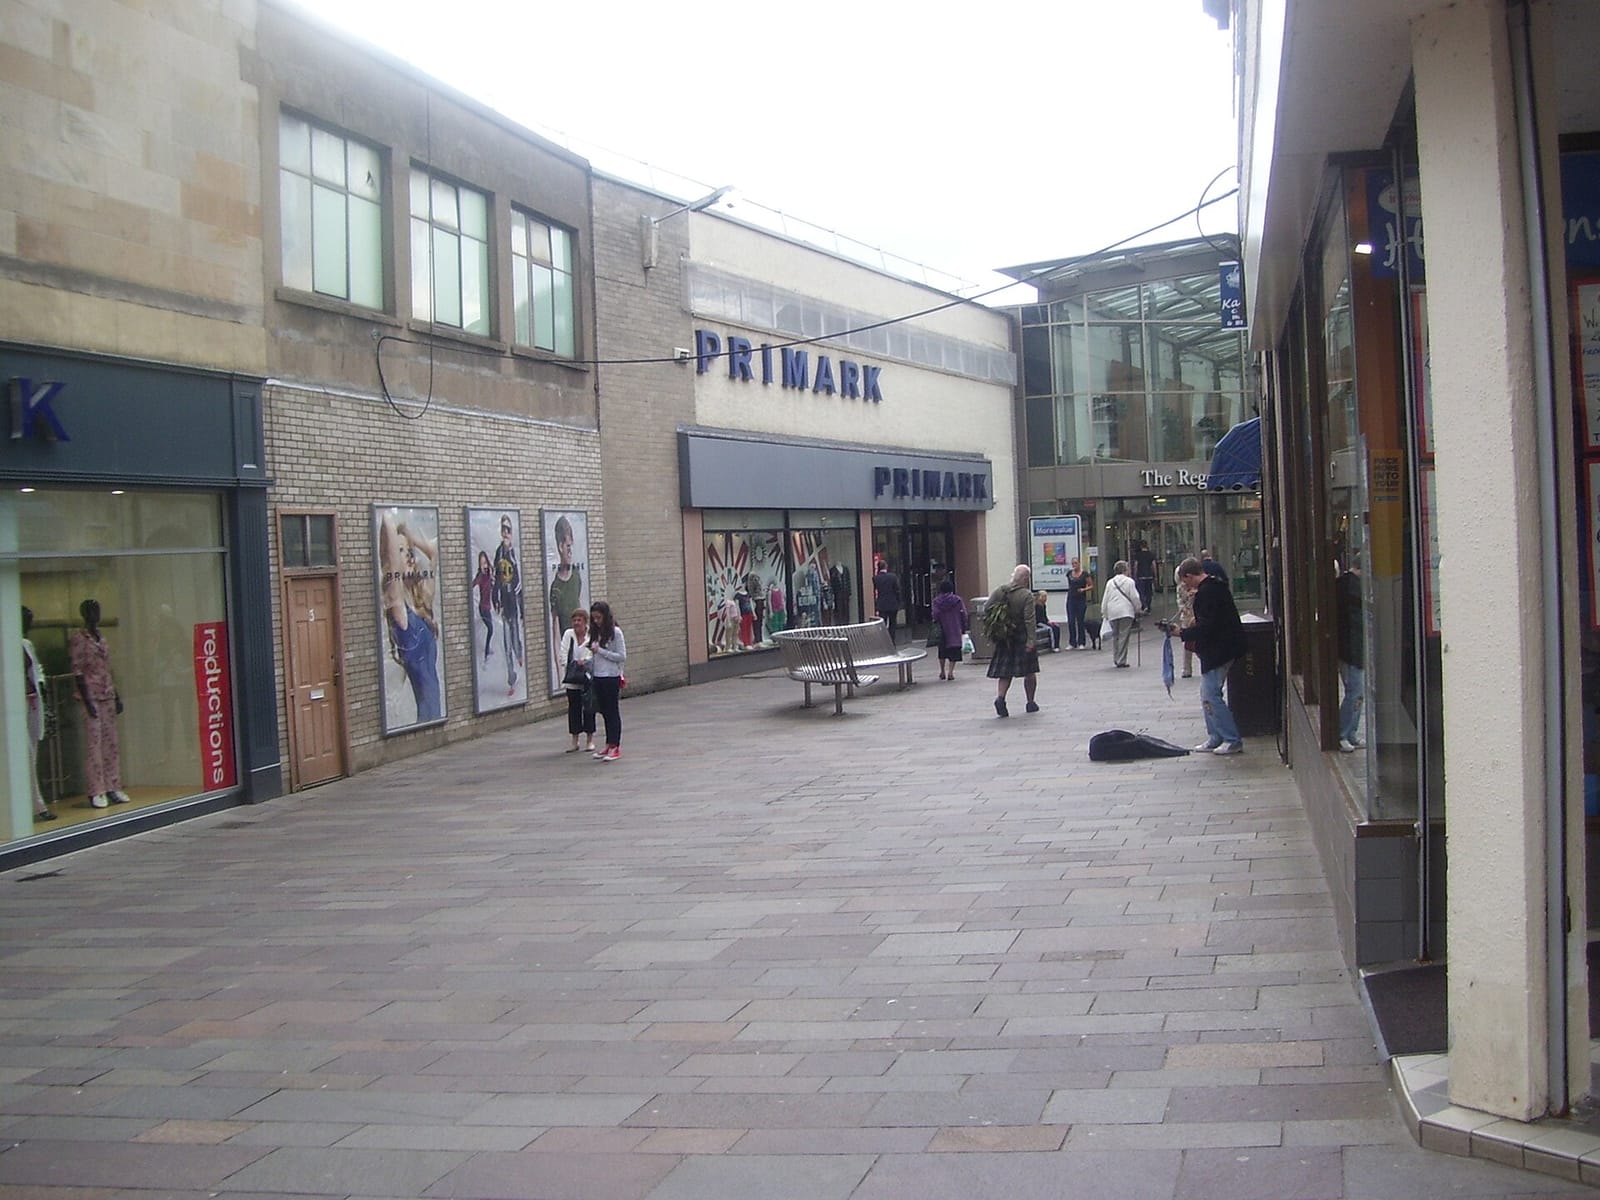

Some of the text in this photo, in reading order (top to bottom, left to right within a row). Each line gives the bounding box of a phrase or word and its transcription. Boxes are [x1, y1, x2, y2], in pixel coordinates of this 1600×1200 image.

[695, 329, 884, 403] PRIMARK
[8, 376, 71, 441] K
[874, 466, 988, 500] PRIMARK
[1141, 469, 1172, 487] The
[1035, 525, 1074, 535] More value
[386, 570, 434, 582] PRIMARK
[203, 628, 225, 784] reductions
